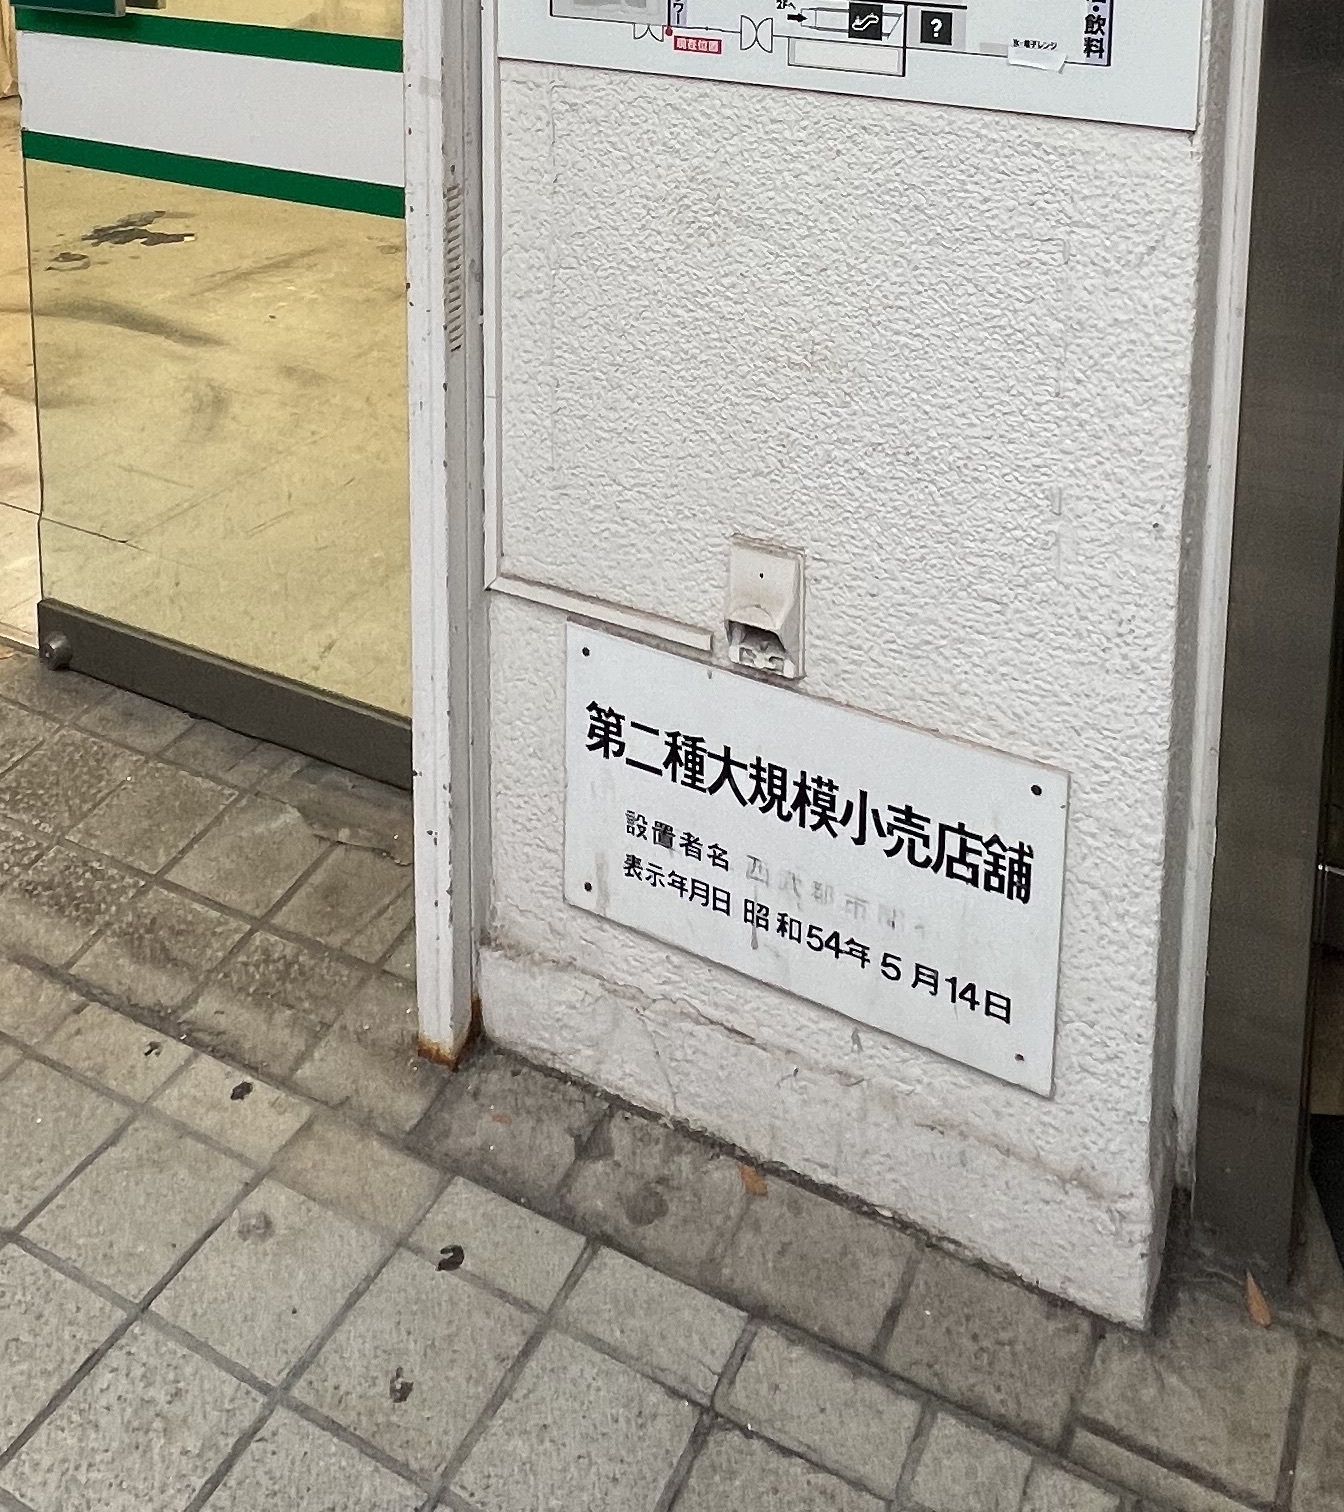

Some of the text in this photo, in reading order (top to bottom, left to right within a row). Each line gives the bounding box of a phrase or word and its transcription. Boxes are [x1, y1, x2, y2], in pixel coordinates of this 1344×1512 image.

[585, 700, 1034, 905] 第二種大規模小売店舗
[624, 809, 730, 872] 設置者名
[623, 853, 731, 917] 表示年月日
